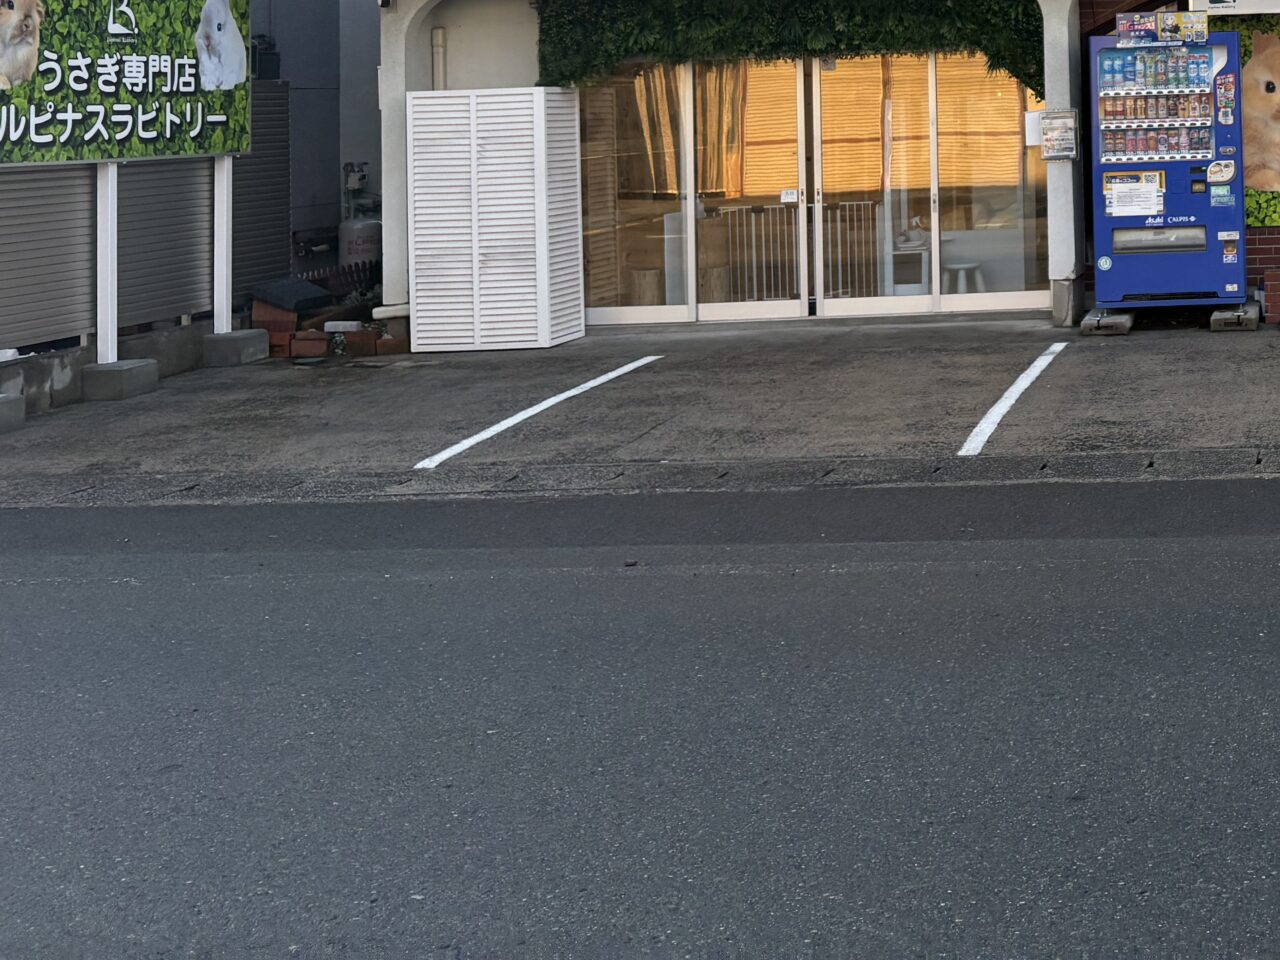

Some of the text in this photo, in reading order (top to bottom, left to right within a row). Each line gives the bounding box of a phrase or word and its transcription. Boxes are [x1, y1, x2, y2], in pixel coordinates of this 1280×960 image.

[38, 49, 197, 93] うさぎ専門店
[0, 100, 228, 143] ルピナスラビトリー
